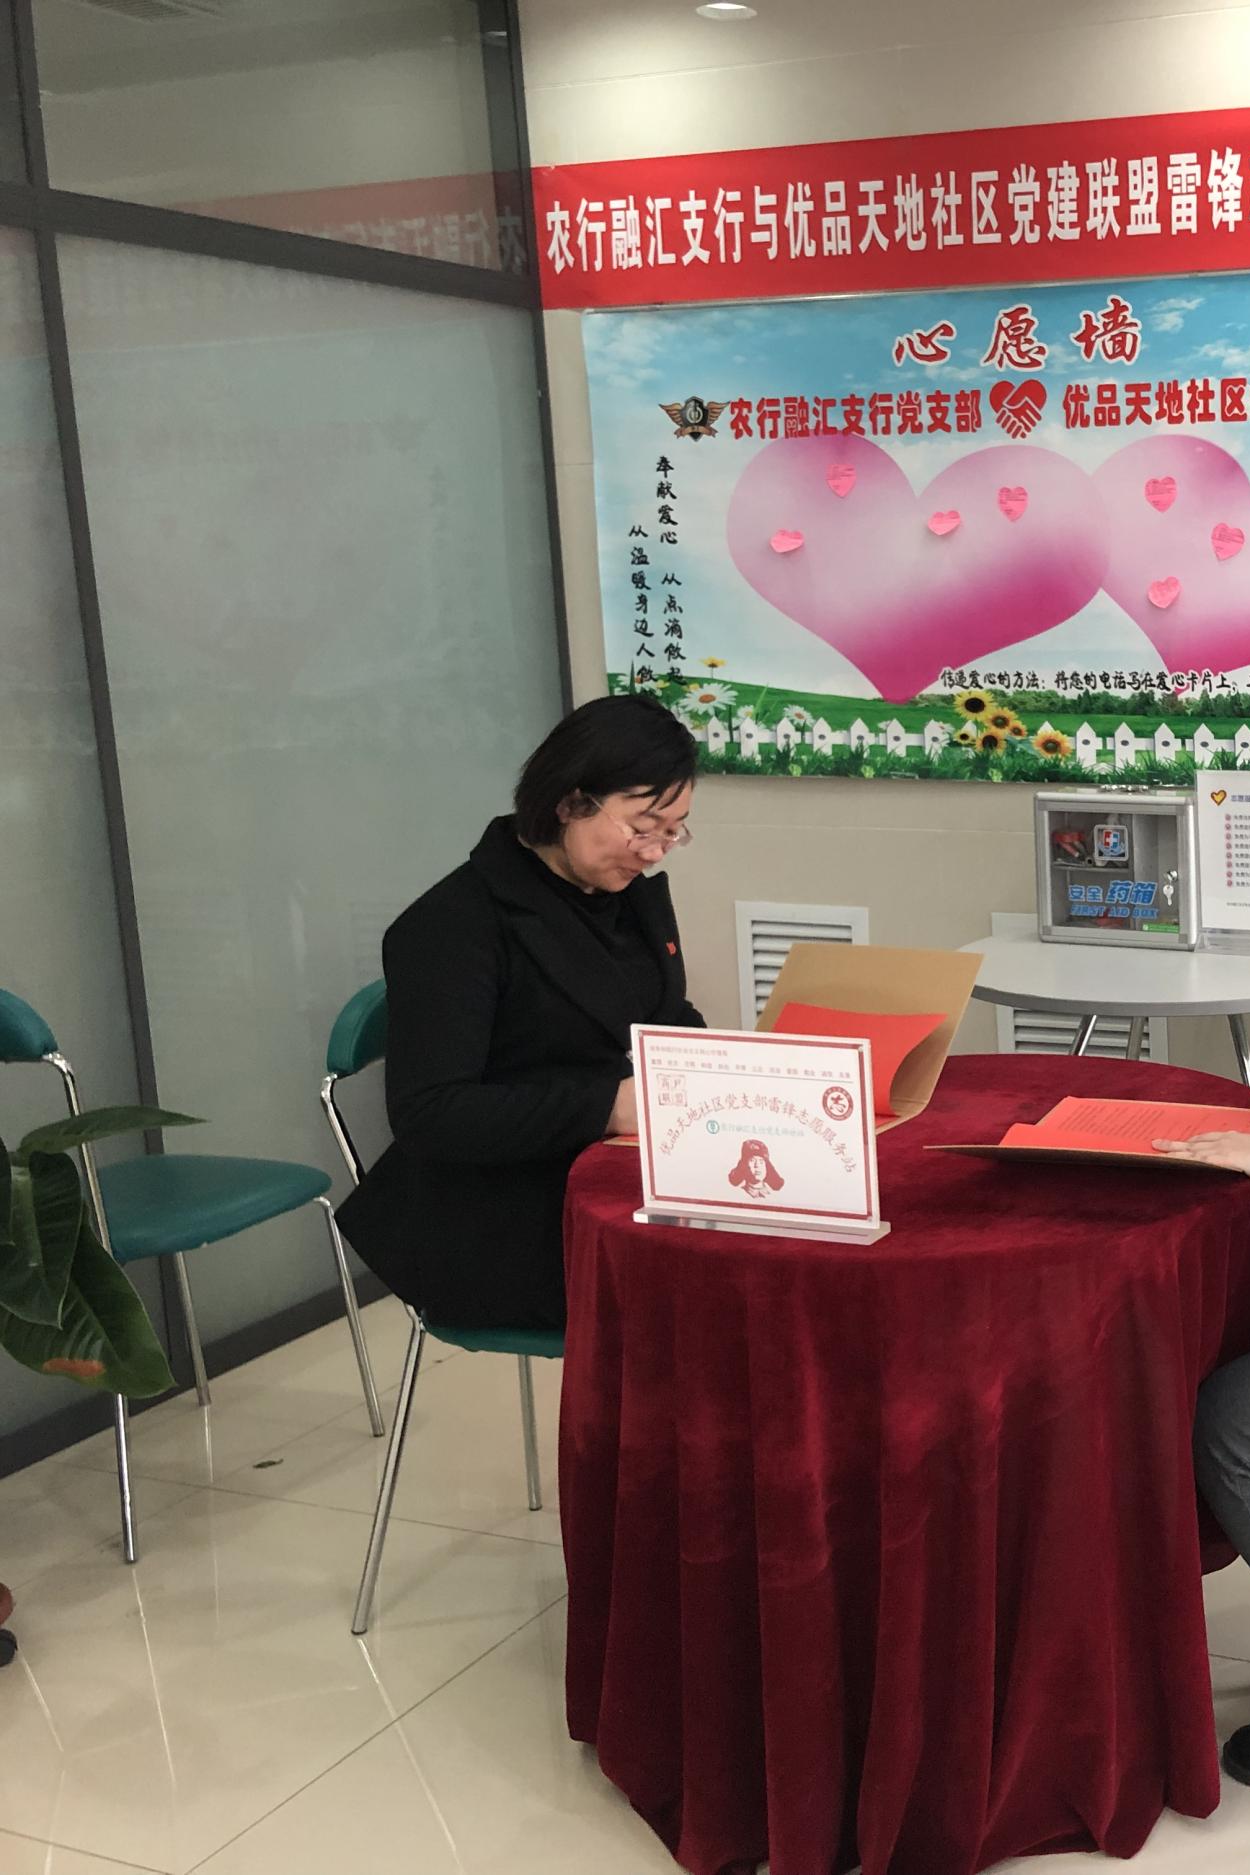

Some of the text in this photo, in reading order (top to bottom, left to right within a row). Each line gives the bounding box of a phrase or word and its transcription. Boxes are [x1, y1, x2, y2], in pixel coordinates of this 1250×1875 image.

[894, 301, 1144, 368] 心愿墙
[729, 388, 983, 440] 农行融汇支行党支部
[656, 456, 678, 545] 奉献爱心
[628, 525, 657, 697] 从温暖身边人做
[659, 1093, 857, 1174] 优品天地社区党支部雷锋志愿服务站
